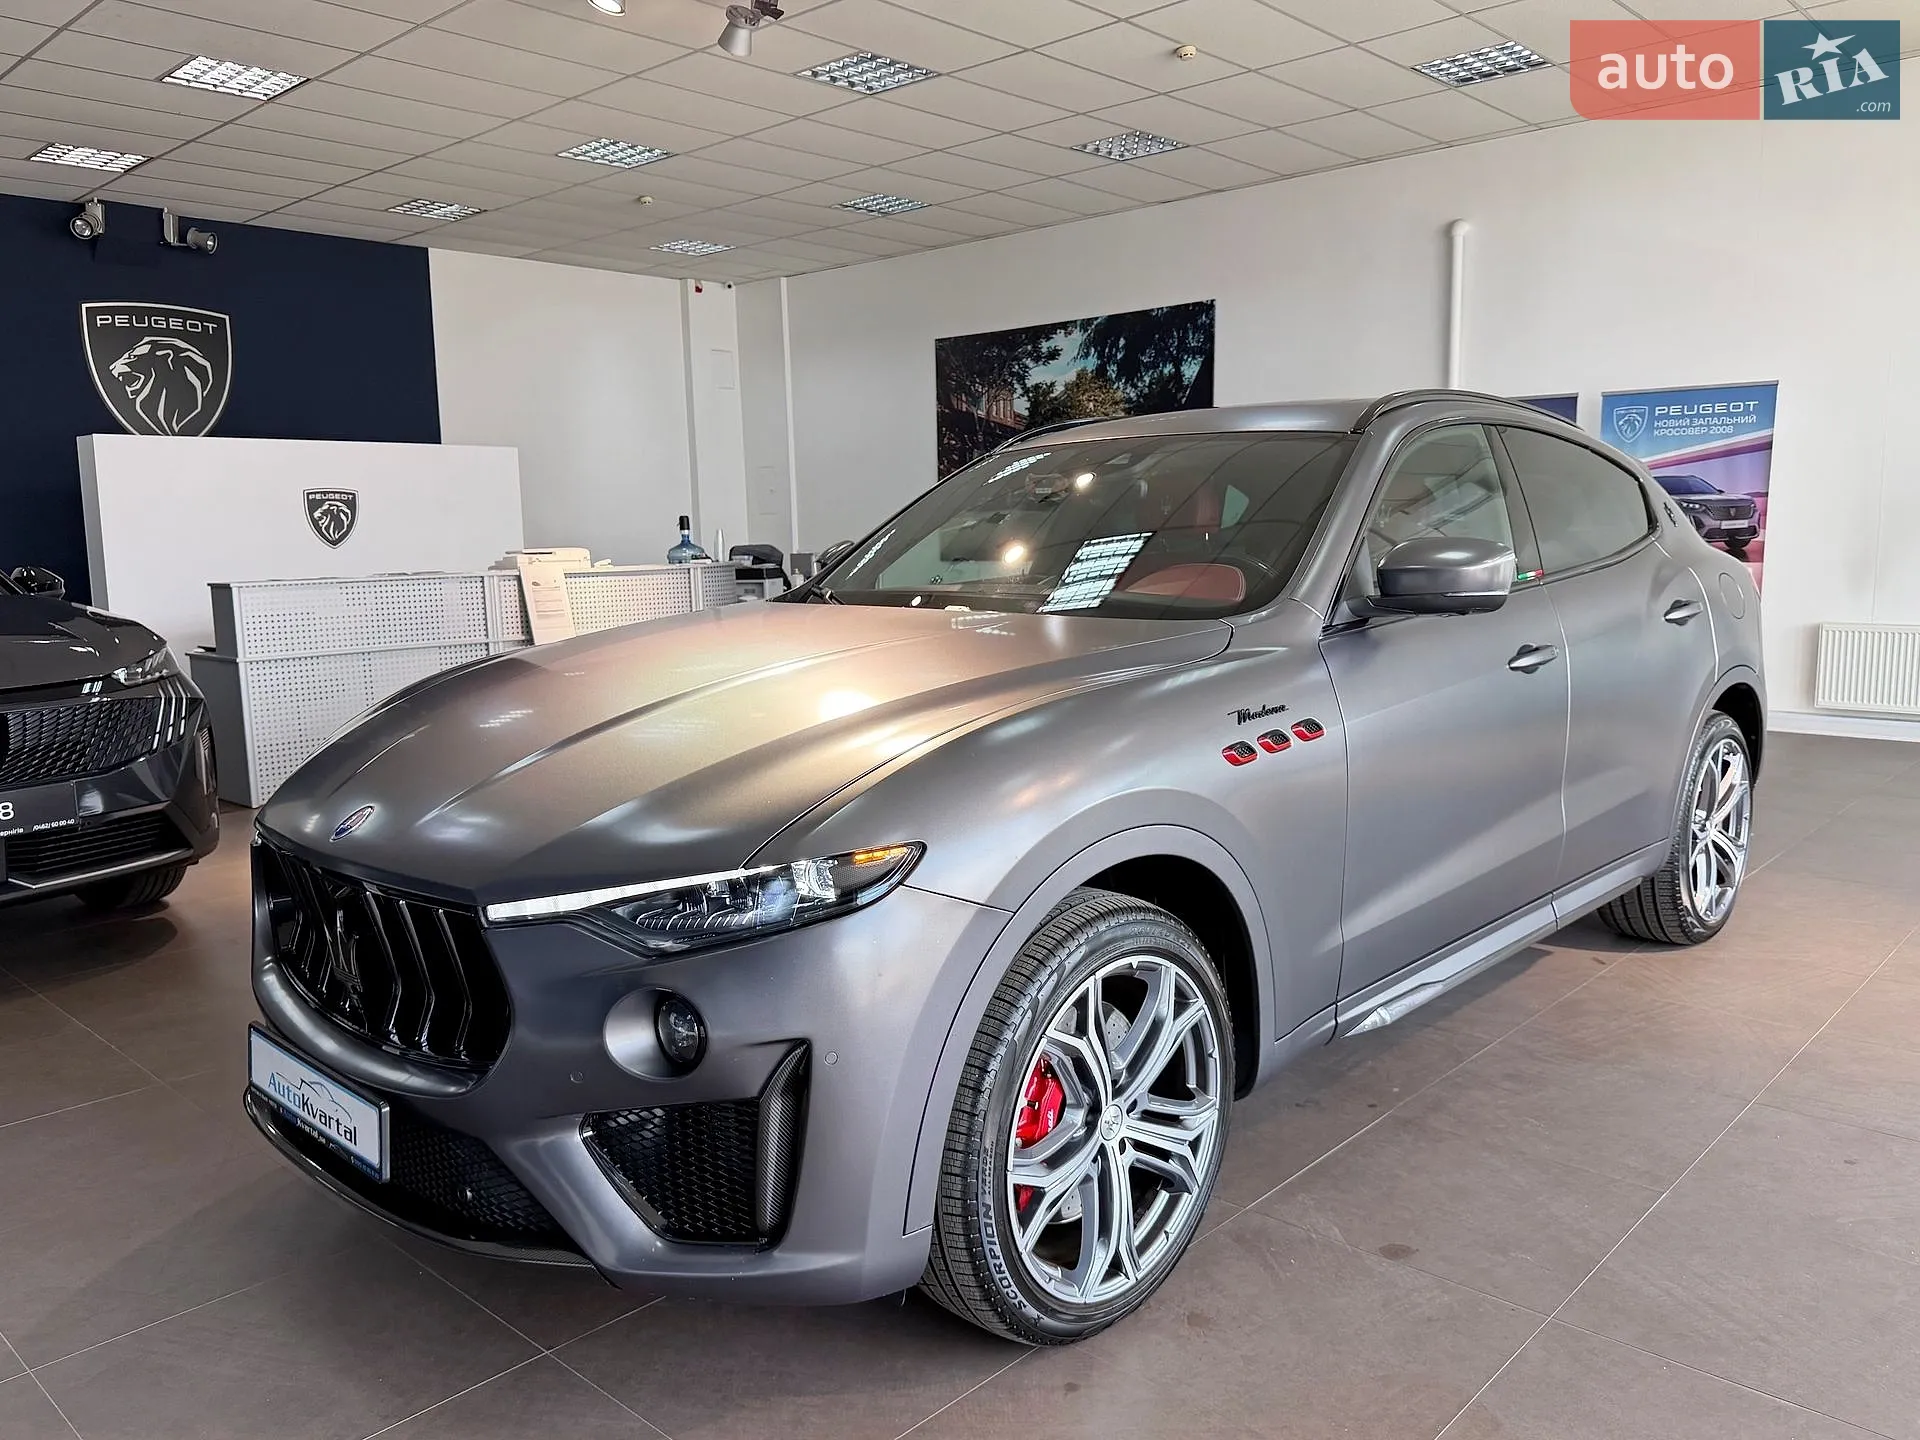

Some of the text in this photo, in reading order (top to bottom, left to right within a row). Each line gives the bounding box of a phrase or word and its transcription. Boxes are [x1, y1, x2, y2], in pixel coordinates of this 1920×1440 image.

[96, 315, 218, 335] PEUGEOT
[1654, 401, 1759, 416] PEUGEOT
[1654, 414, 1757, 428] НОВИЙ ЗАПАЛЬНИЙ
[1653, 425, 1734, 437] КРОСОВЕР 2008
[267, 1071, 358, 1147] AutoKvartal
[983, 1202, 1028, 1310] SCORPION
